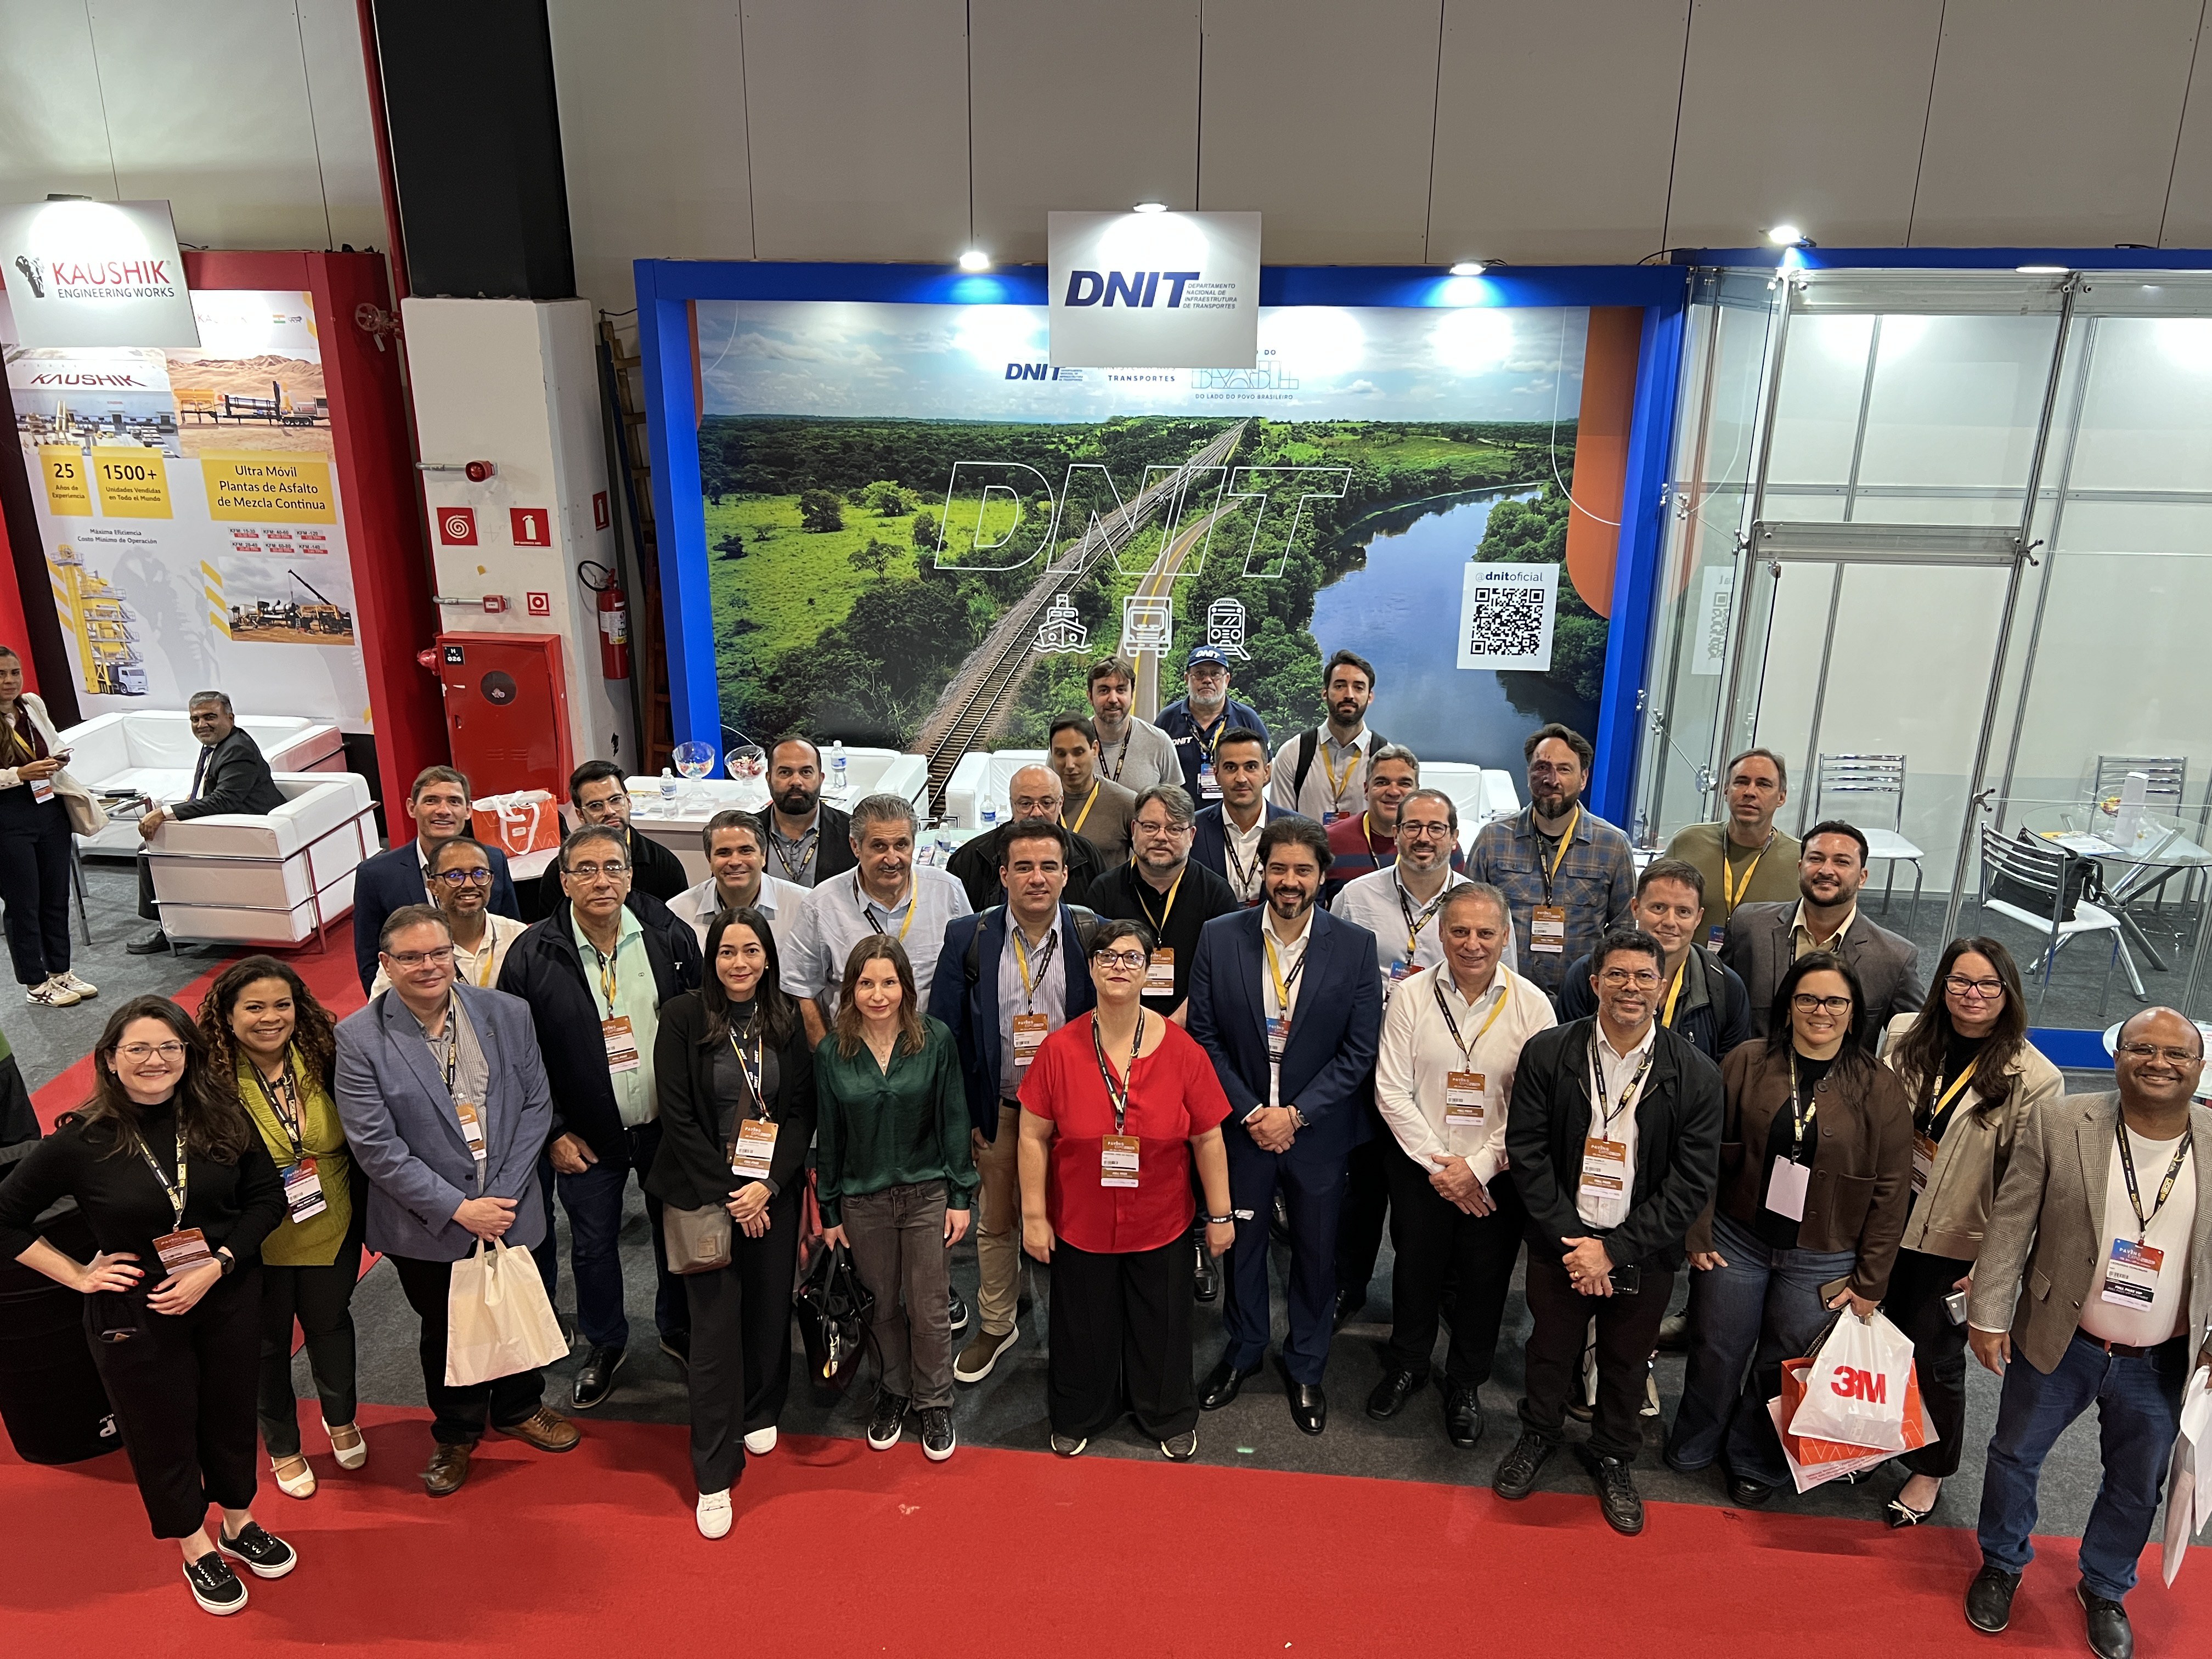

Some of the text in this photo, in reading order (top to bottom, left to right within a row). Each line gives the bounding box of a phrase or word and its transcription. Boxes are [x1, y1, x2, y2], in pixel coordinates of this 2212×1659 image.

[53, 260, 170, 285] KAUSHIK
[58, 287, 174, 298] ENGINEERING WORKS
[1065, 270, 1200, 308] DNIT
[31, 374, 147, 387] KAUSHIK
[54, 463, 74, 478] 25
[235, 465, 297, 477] Ultra Móvil
[219, 481, 318, 494] Plantas de Asfalto
[218, 496, 325, 510] de Mezcla Continua
[934, 461, 1352, 578] DNIT
[1475, 572, 1543, 582] @dnitoficial
[1195, 650, 1220, 658] DNIT
[2119, 1248, 2141, 1257] PAVING
[1831, 1365, 1886, 1404] 3M
